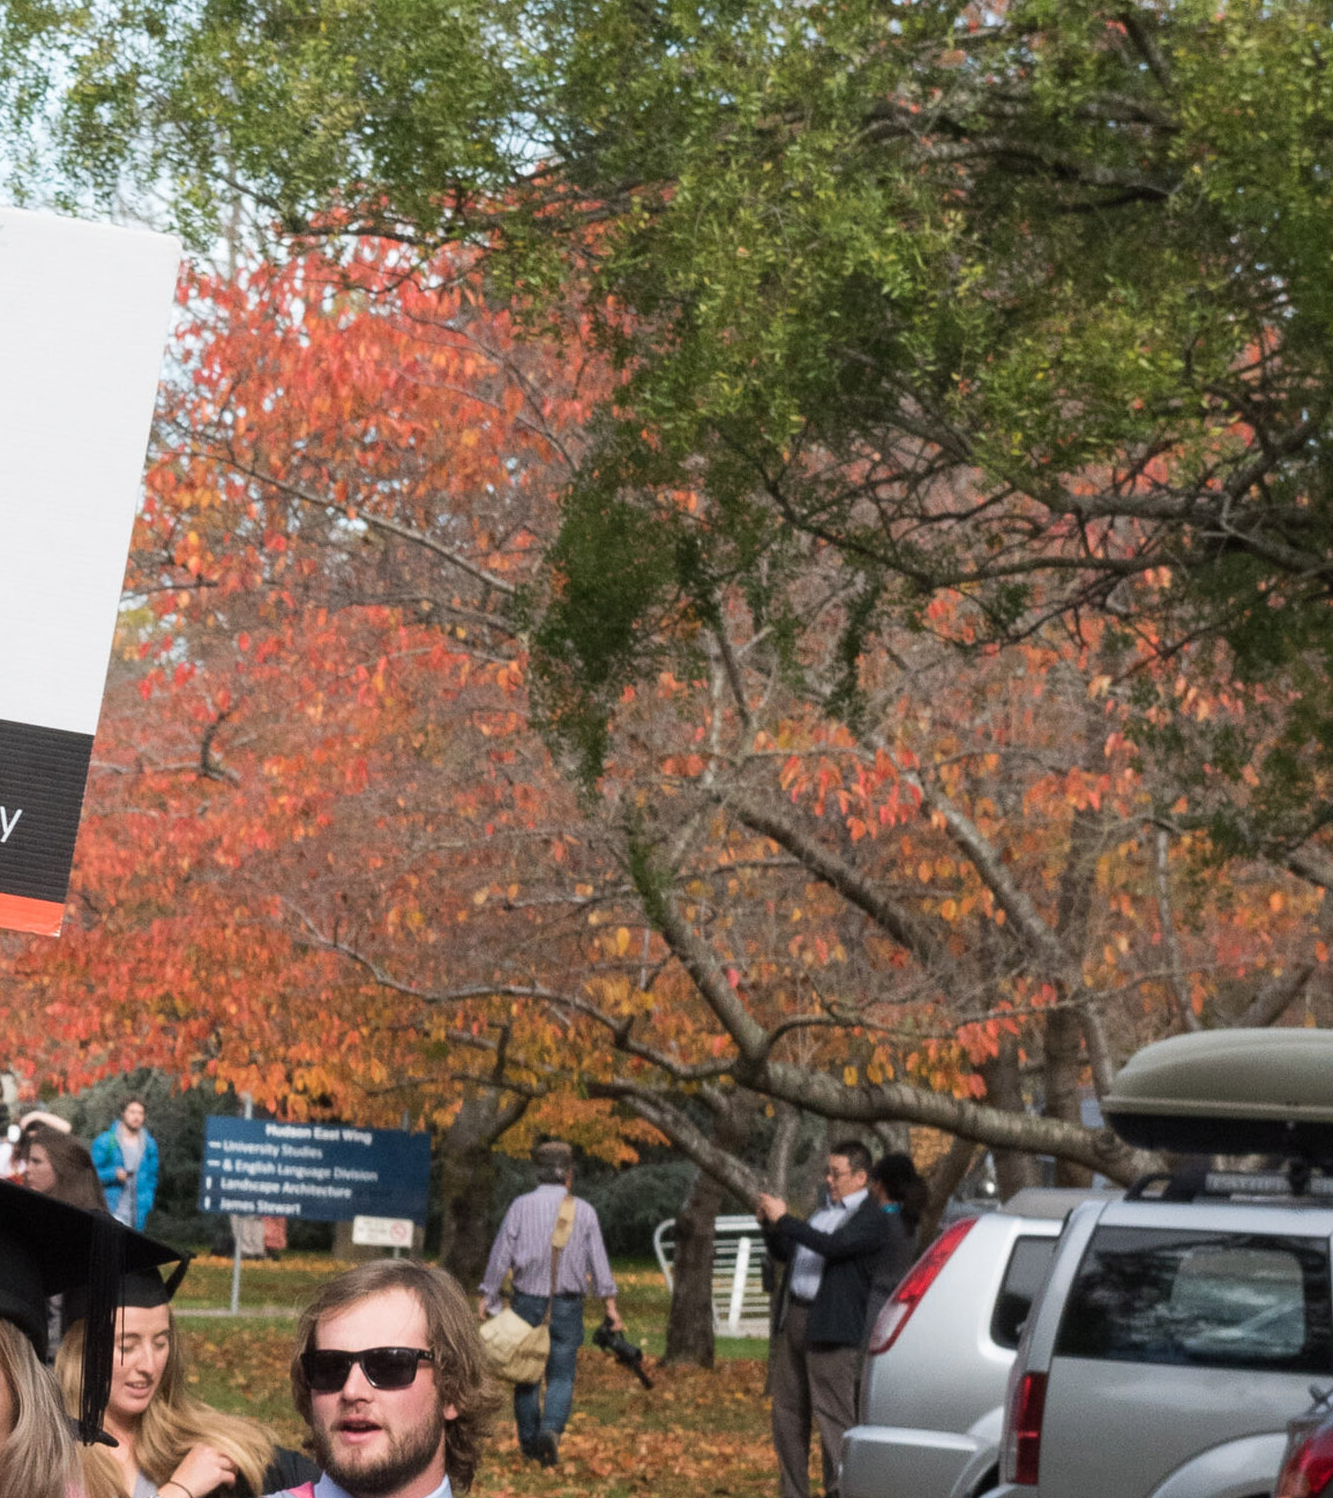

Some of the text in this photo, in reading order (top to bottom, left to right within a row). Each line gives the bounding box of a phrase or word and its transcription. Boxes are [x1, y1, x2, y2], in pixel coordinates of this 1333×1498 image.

[313, 1126, 340, 1141] East
[342, 1129, 373, 1146] Wing
[223, 1140, 323, 1159] University Studies
[222, 1158, 378, 1182] & English Language Division
[221, 1177, 353, 1199] Landscape Architecture
[220, 1197, 301, 1216] James Stewart
